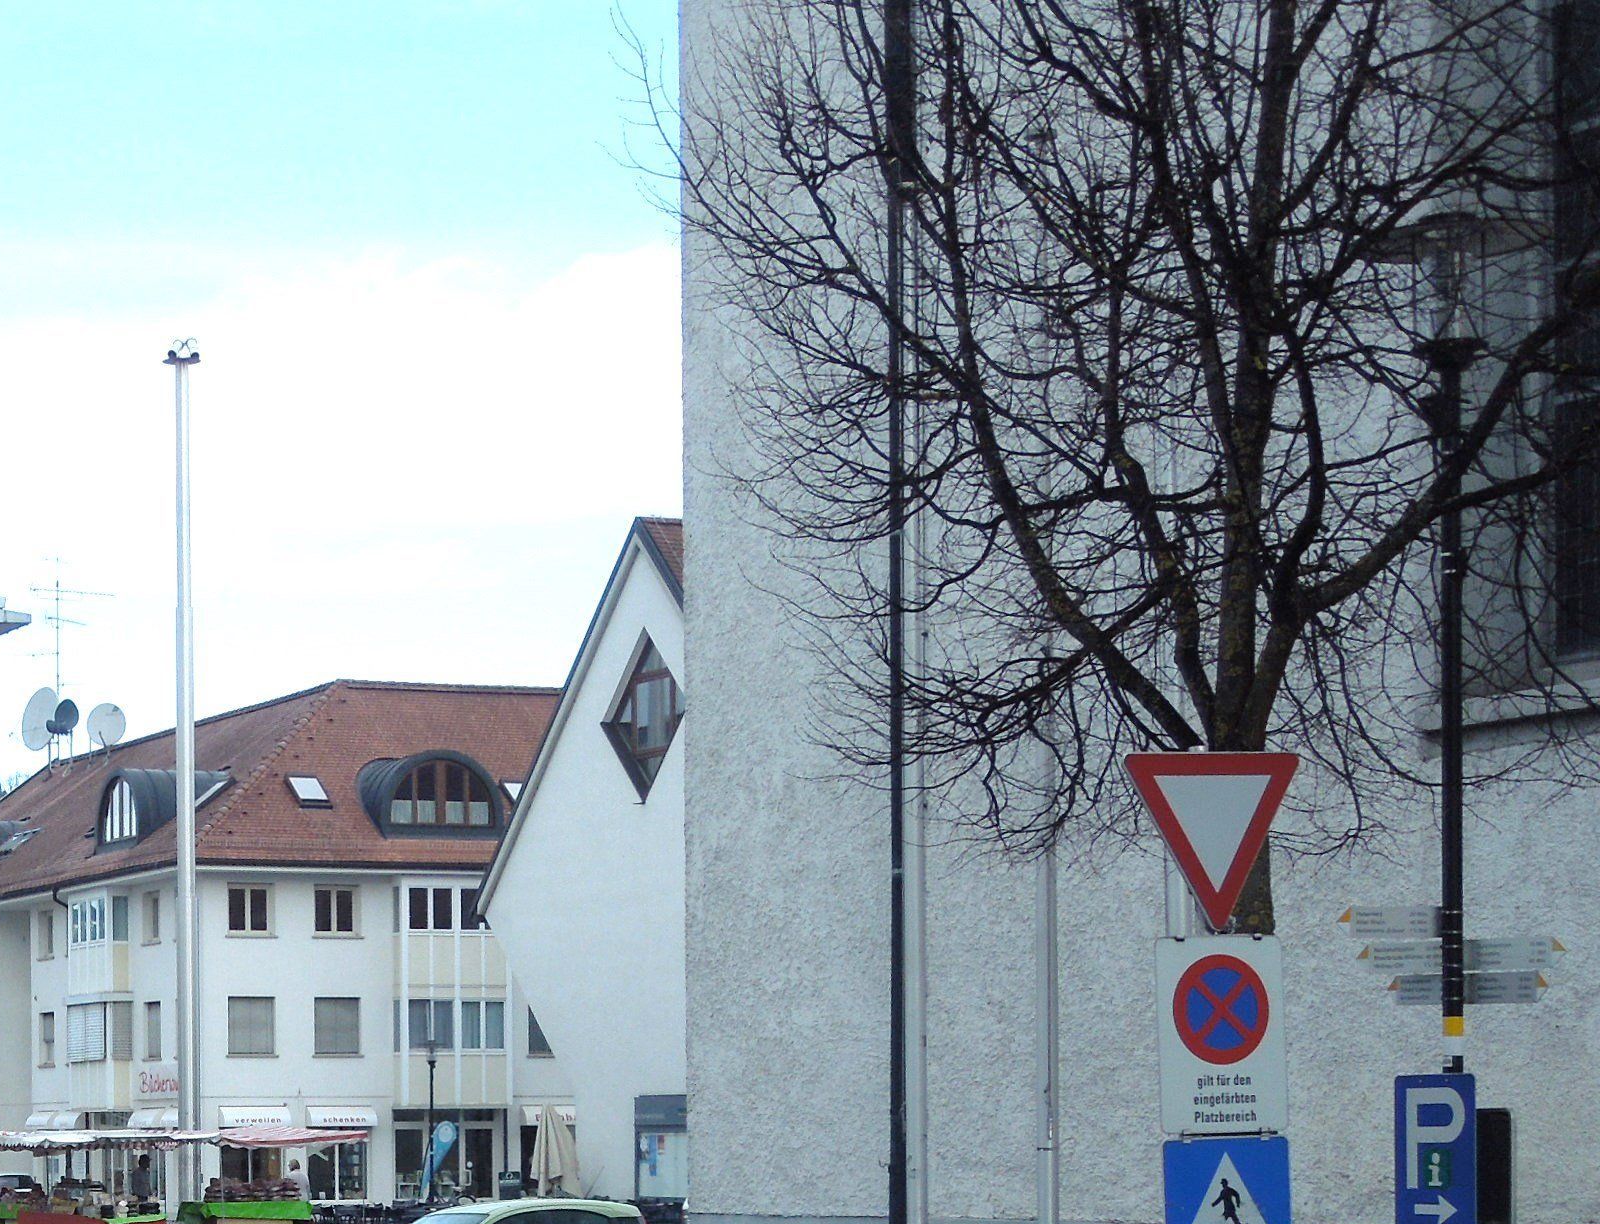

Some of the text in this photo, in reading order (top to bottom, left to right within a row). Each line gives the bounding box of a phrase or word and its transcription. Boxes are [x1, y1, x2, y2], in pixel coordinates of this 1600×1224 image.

[1197, 1073, 1252, 1089] gilt für den
[1193, 1092, 1257, 1107] eingefärbten
[234, 1116, 283, 1124] verweilen
[322, 1115, 368, 1123] schenken
[1194, 1109, 1257, 1123] Platzbereich
[1406, 1086, 1466, 1190] P
